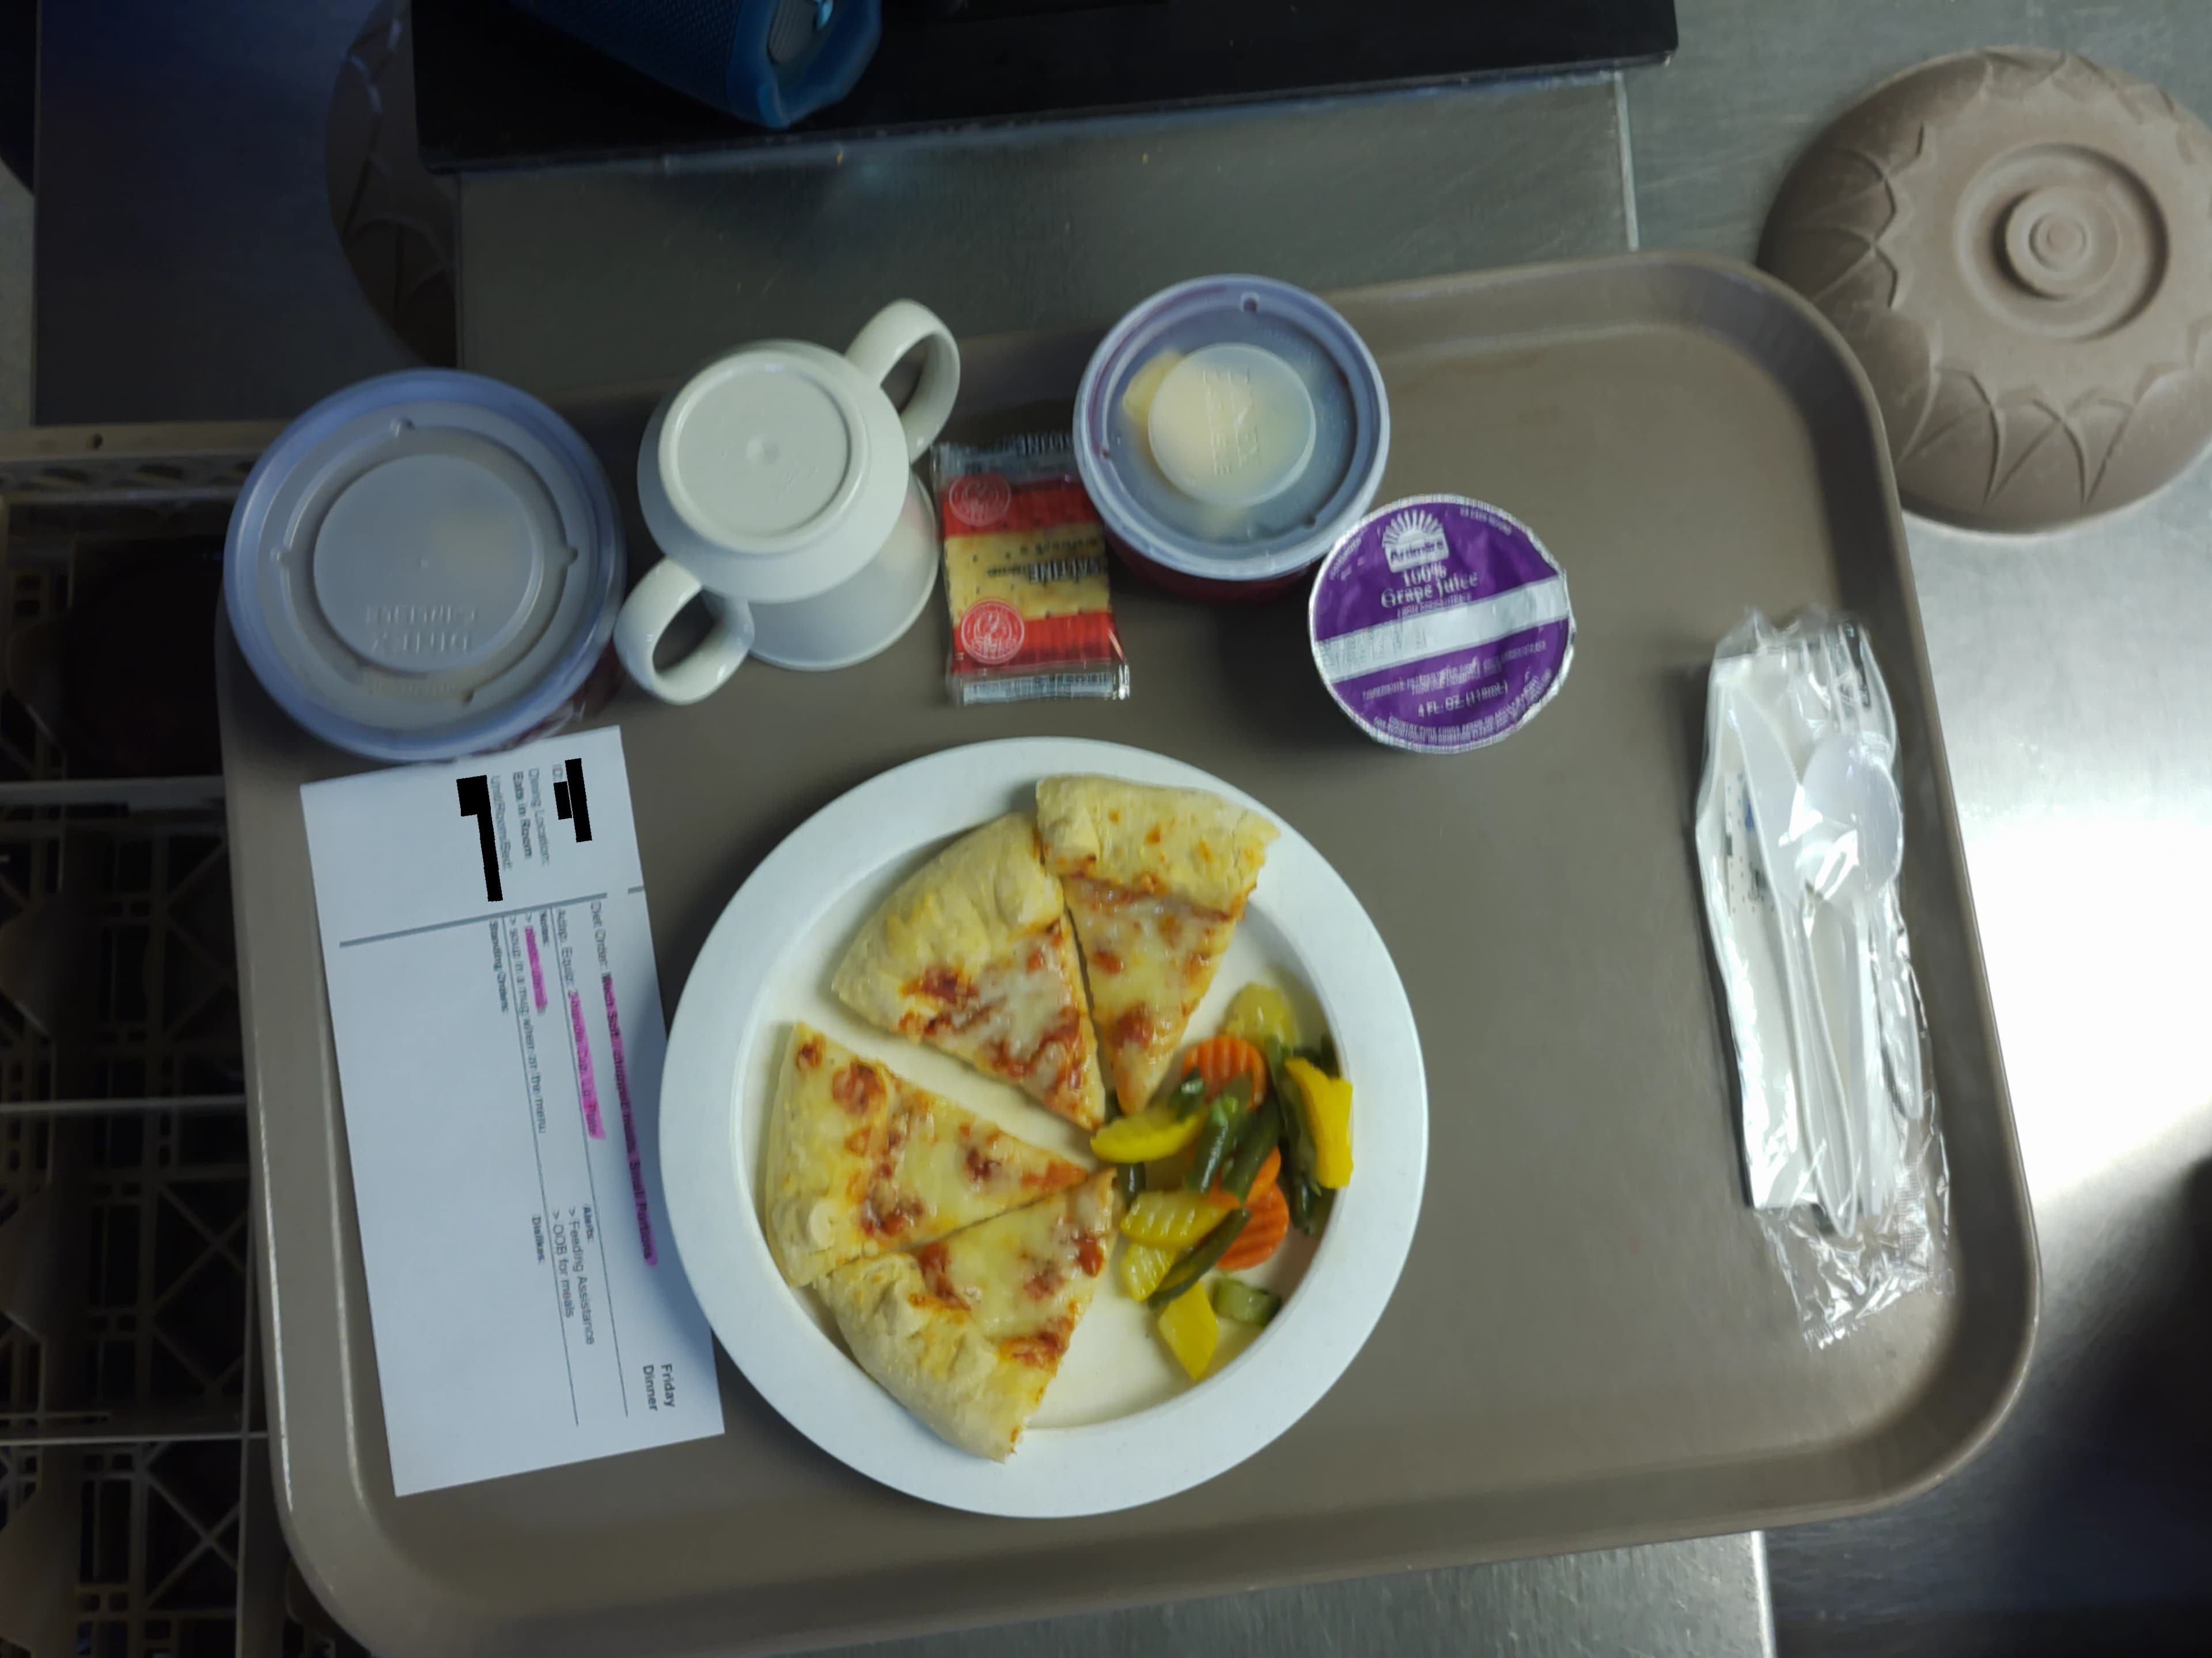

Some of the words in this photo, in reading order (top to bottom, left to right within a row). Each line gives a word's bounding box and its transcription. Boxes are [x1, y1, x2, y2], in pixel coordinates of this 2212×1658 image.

[1381, 584, 1433, 608] Grape
[1437, 572, 1478, 598] Juice
[1402, 562, 1448, 587] 100%
[514, 771, 525, 800] Eats
[521, 819, 533, 859] Room
[554, 1224, 566, 1255] OOB
[637, 1202, 653, 1259] Portions
[559, 1258, 569, 1274] for
[567, 1220, 585, 1271] Feeding
[577, 1275, 595, 1345] Assistance
[562, 1279, 574, 1318] meals
[644, 1364, 658, 1411] Dinner
[659, 1363, 677, 1408] Friday
